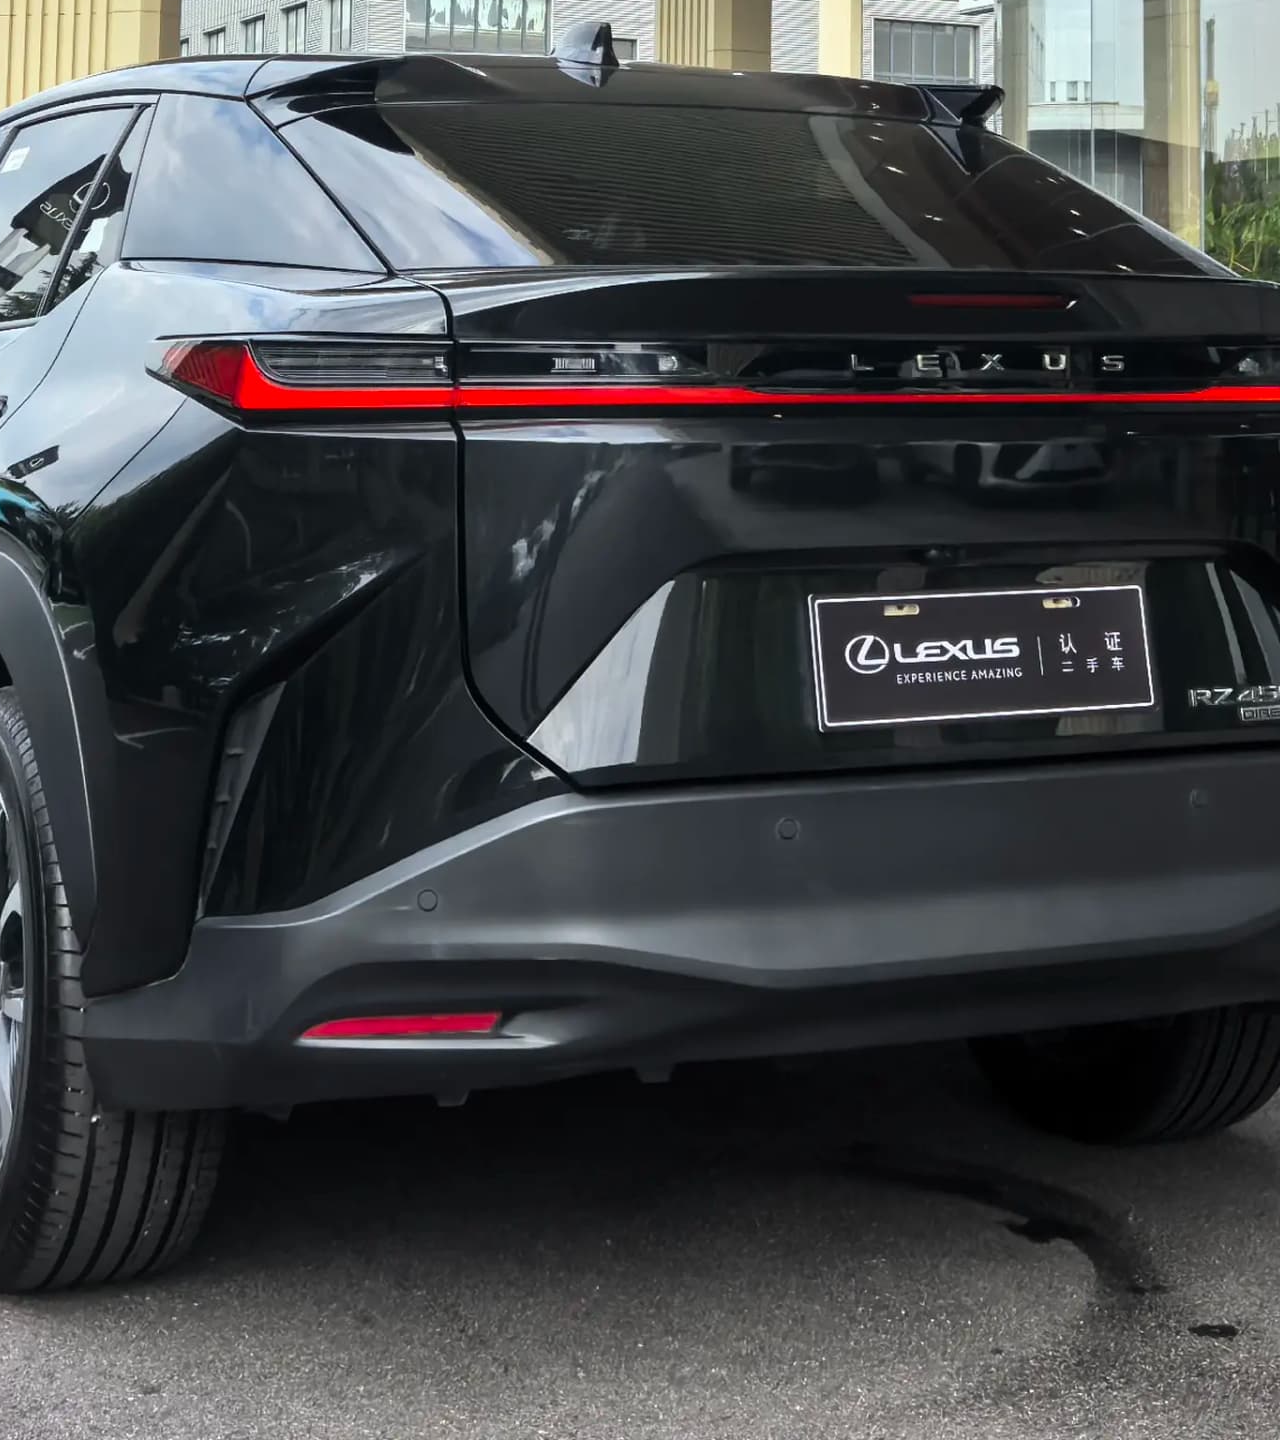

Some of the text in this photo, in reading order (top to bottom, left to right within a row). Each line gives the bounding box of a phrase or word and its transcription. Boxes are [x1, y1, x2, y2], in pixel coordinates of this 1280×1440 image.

[850, 353, 1125, 372] LEXUS
[893, 637, 1020, 663] LEXUS
[1059, 632, 1123, 654] 认证
[1062, 656, 1126, 674] 二手车
[896, 667, 1024, 685] EXPERIENCE AMAZING
[1188, 687, 1235, 707] RZ
